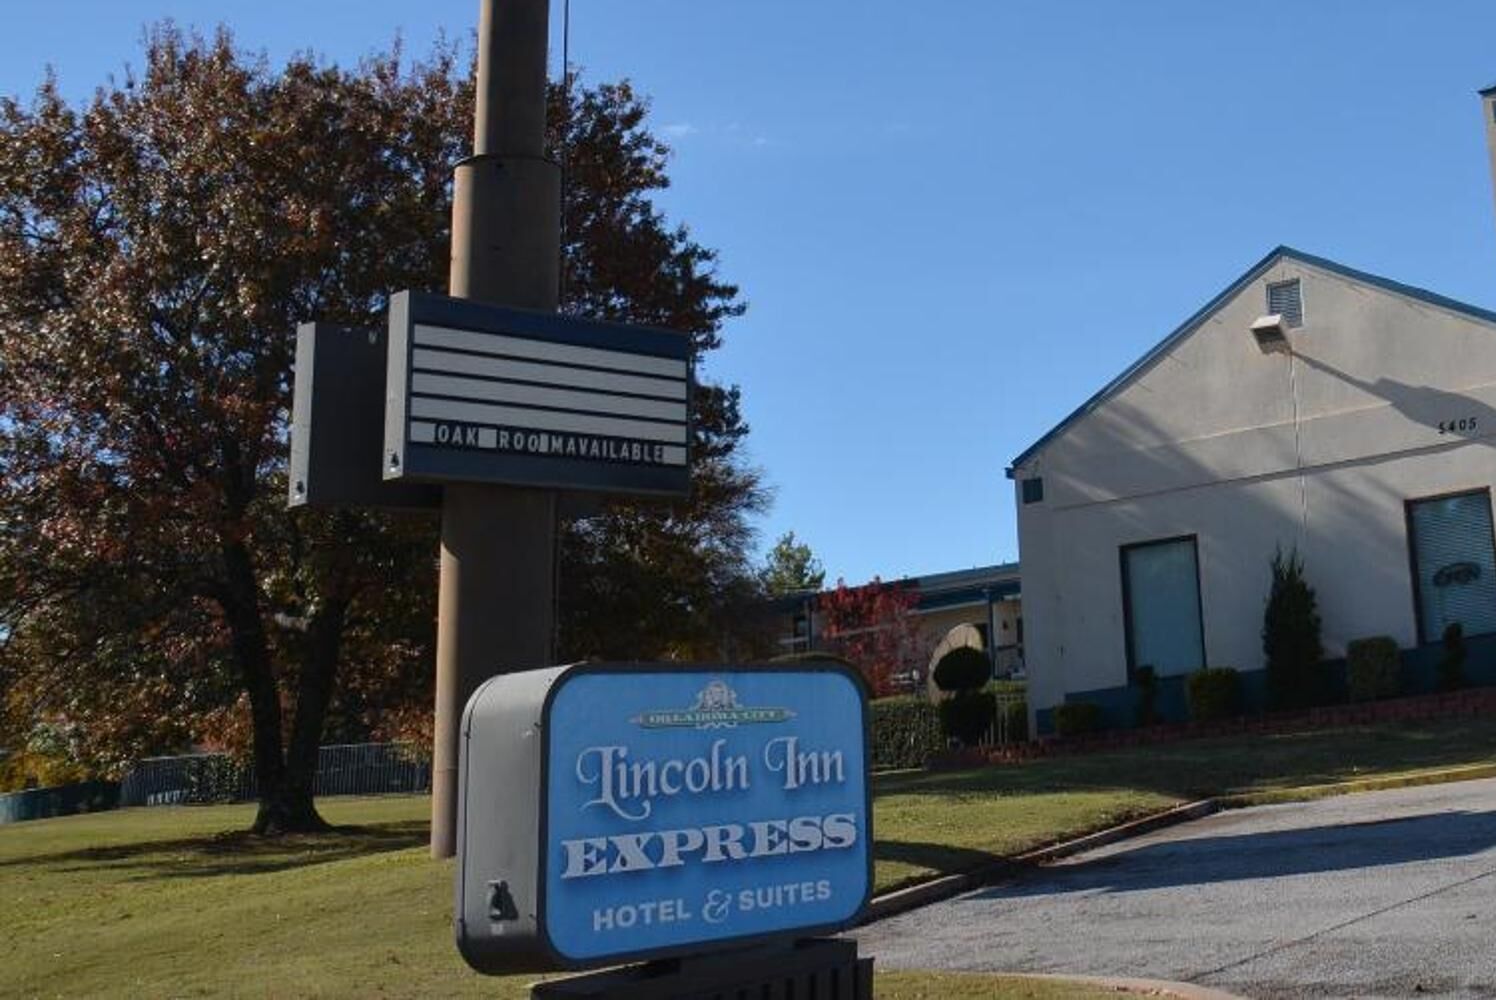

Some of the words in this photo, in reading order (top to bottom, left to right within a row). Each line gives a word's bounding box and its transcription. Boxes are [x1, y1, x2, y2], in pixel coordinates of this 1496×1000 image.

[437, 424, 479, 443] OAK
[1438, 417, 1477, 434] 5405
[576, 739, 750, 821] Lincoln
[764, 737, 846, 790] Inn
[560, 813, 857, 880] EXPRESS
[593, 898, 691, 931] HOTEL
[702, 889, 732, 924] &
[739, 881, 831, 912] SUITES
